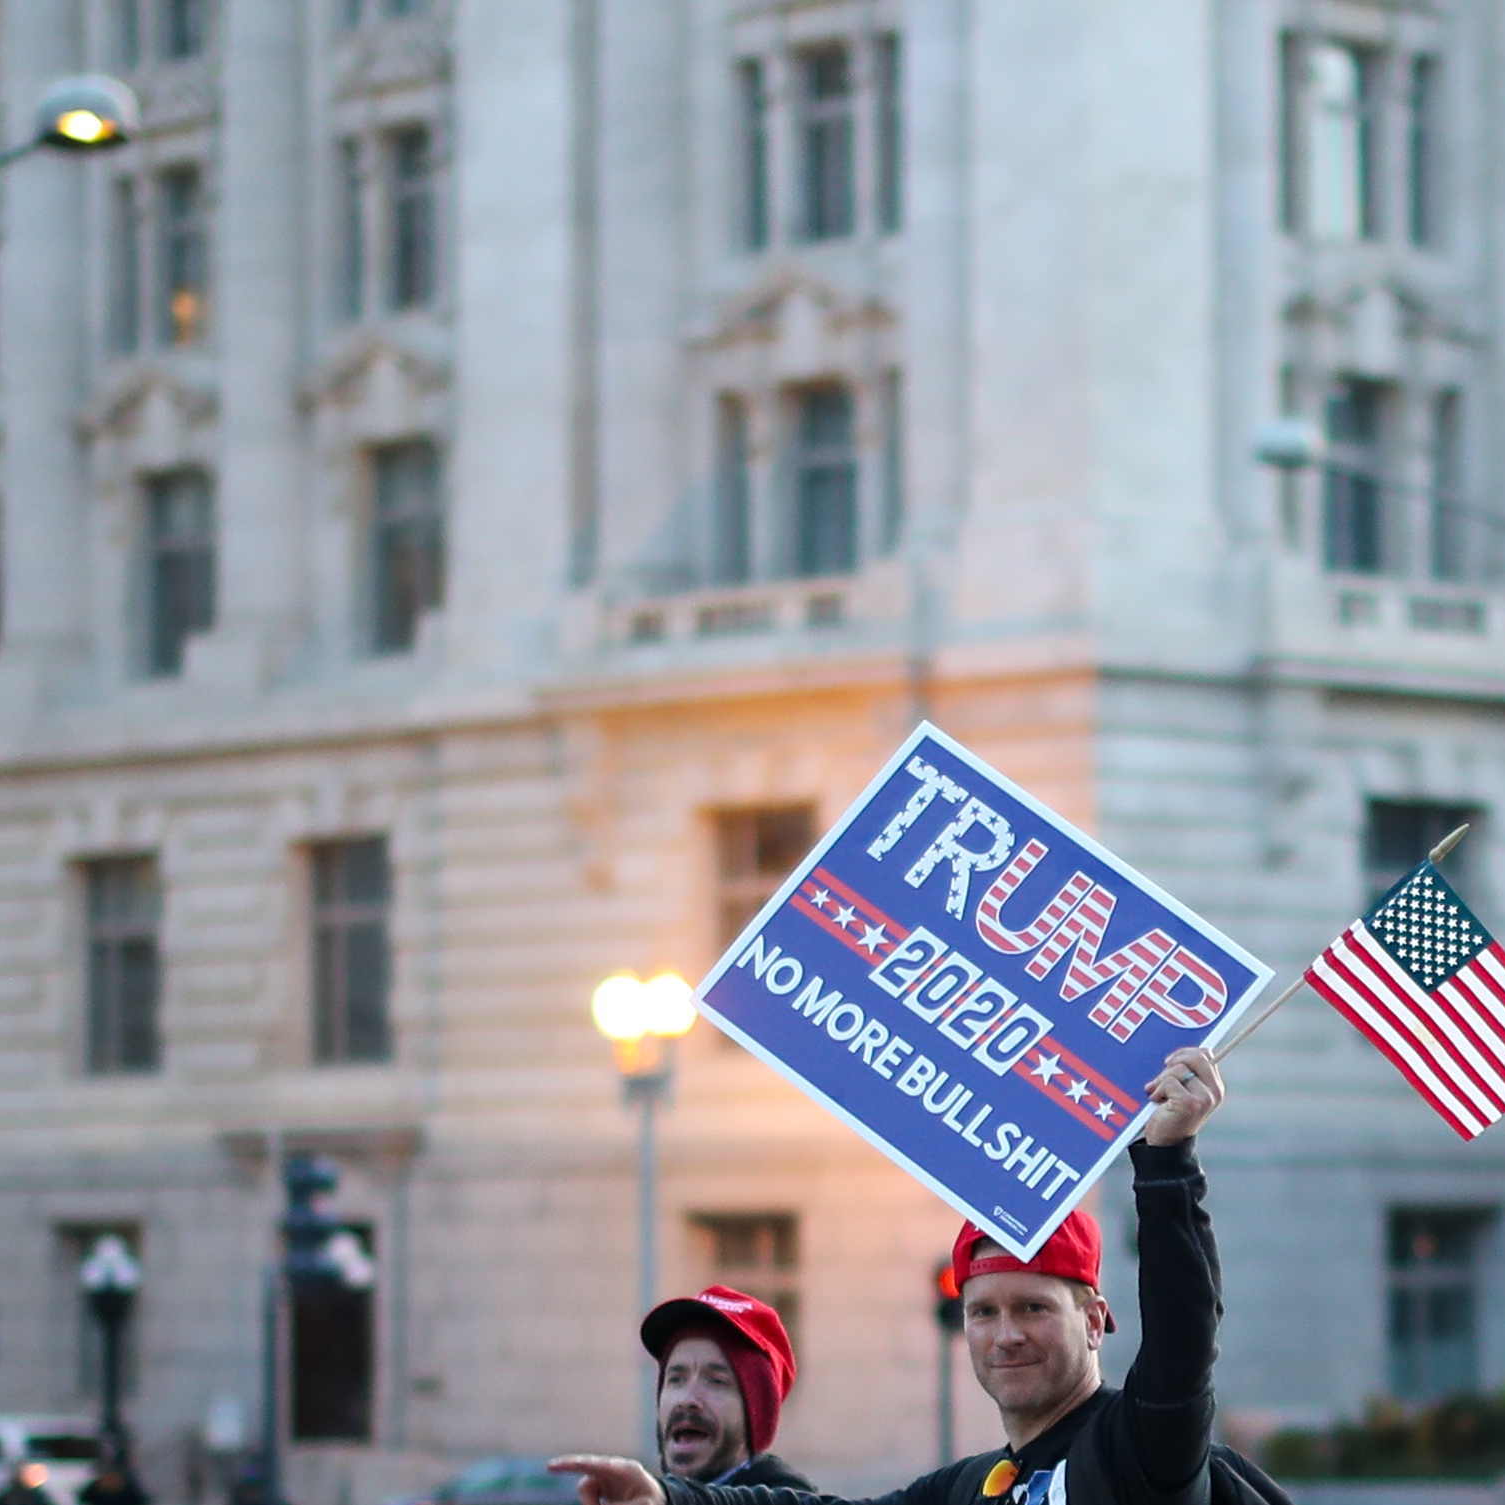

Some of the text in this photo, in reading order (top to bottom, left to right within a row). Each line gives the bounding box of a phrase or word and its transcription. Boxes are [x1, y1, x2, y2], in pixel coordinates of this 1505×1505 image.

[866, 755, 1228, 1044] TRUMP
[869, 926, 1054, 1076] 2020
[737, 934, 1081, 1200] NO MORE BULLSHIT
